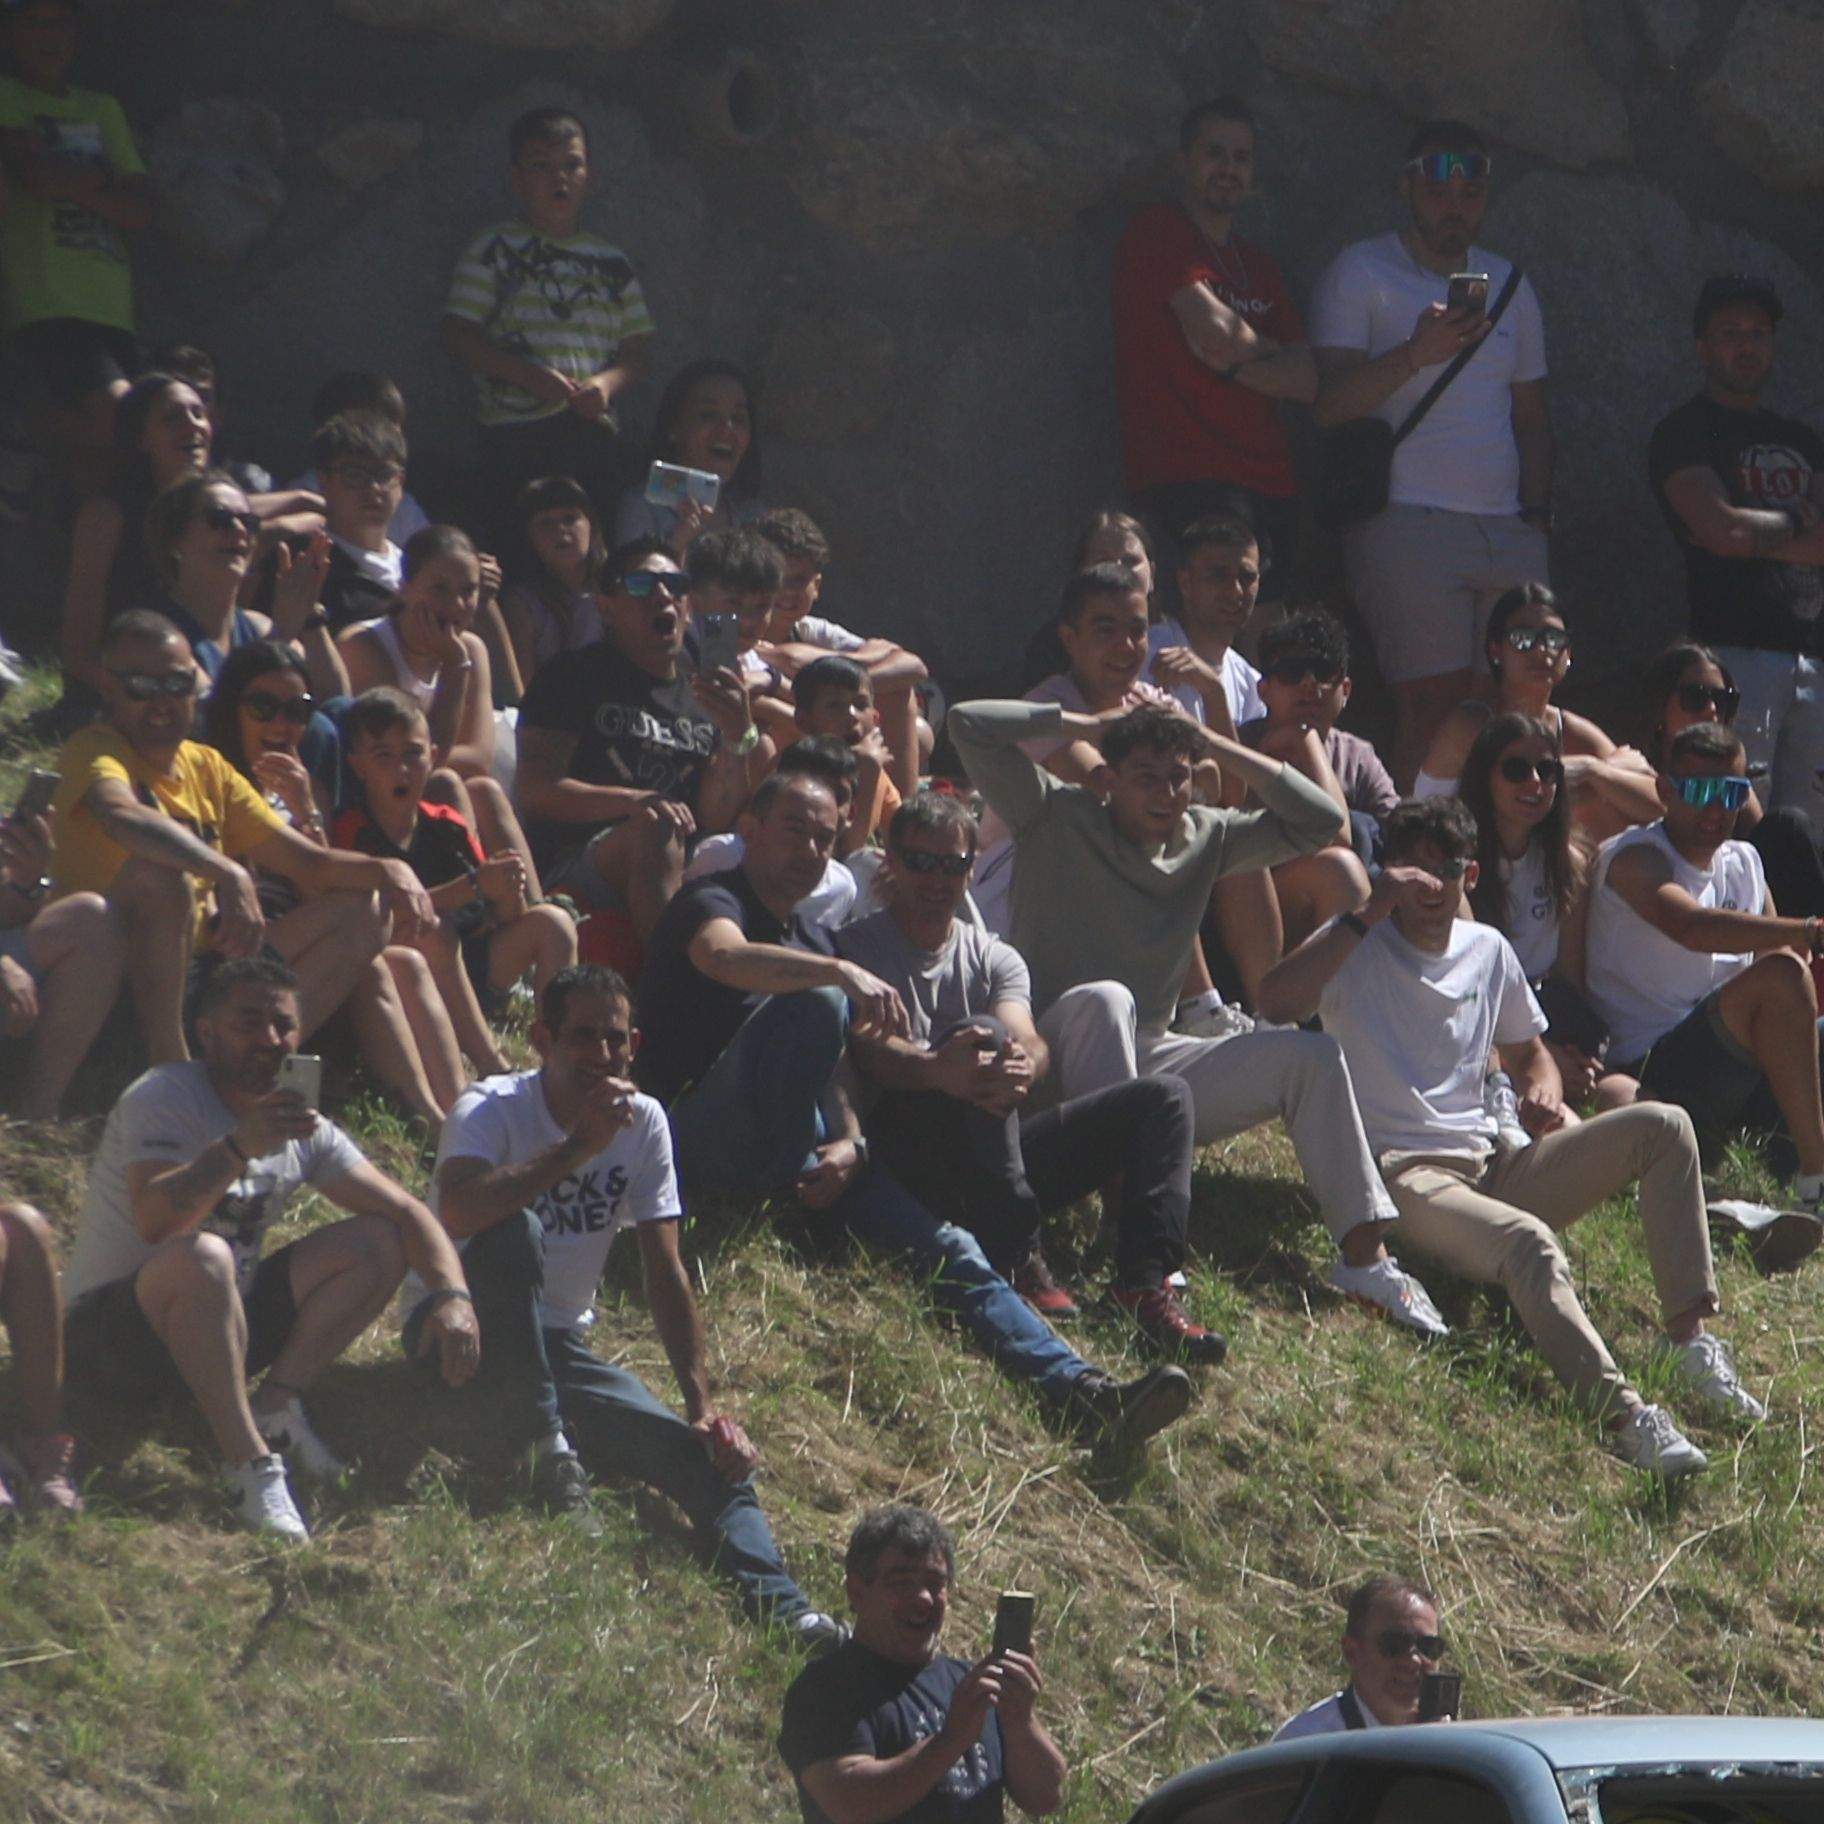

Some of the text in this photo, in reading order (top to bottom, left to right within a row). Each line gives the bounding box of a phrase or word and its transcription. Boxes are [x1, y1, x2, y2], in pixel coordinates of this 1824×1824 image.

[541, 1165, 627, 1203] CK &
[536, 1197, 620, 1235] ONE
